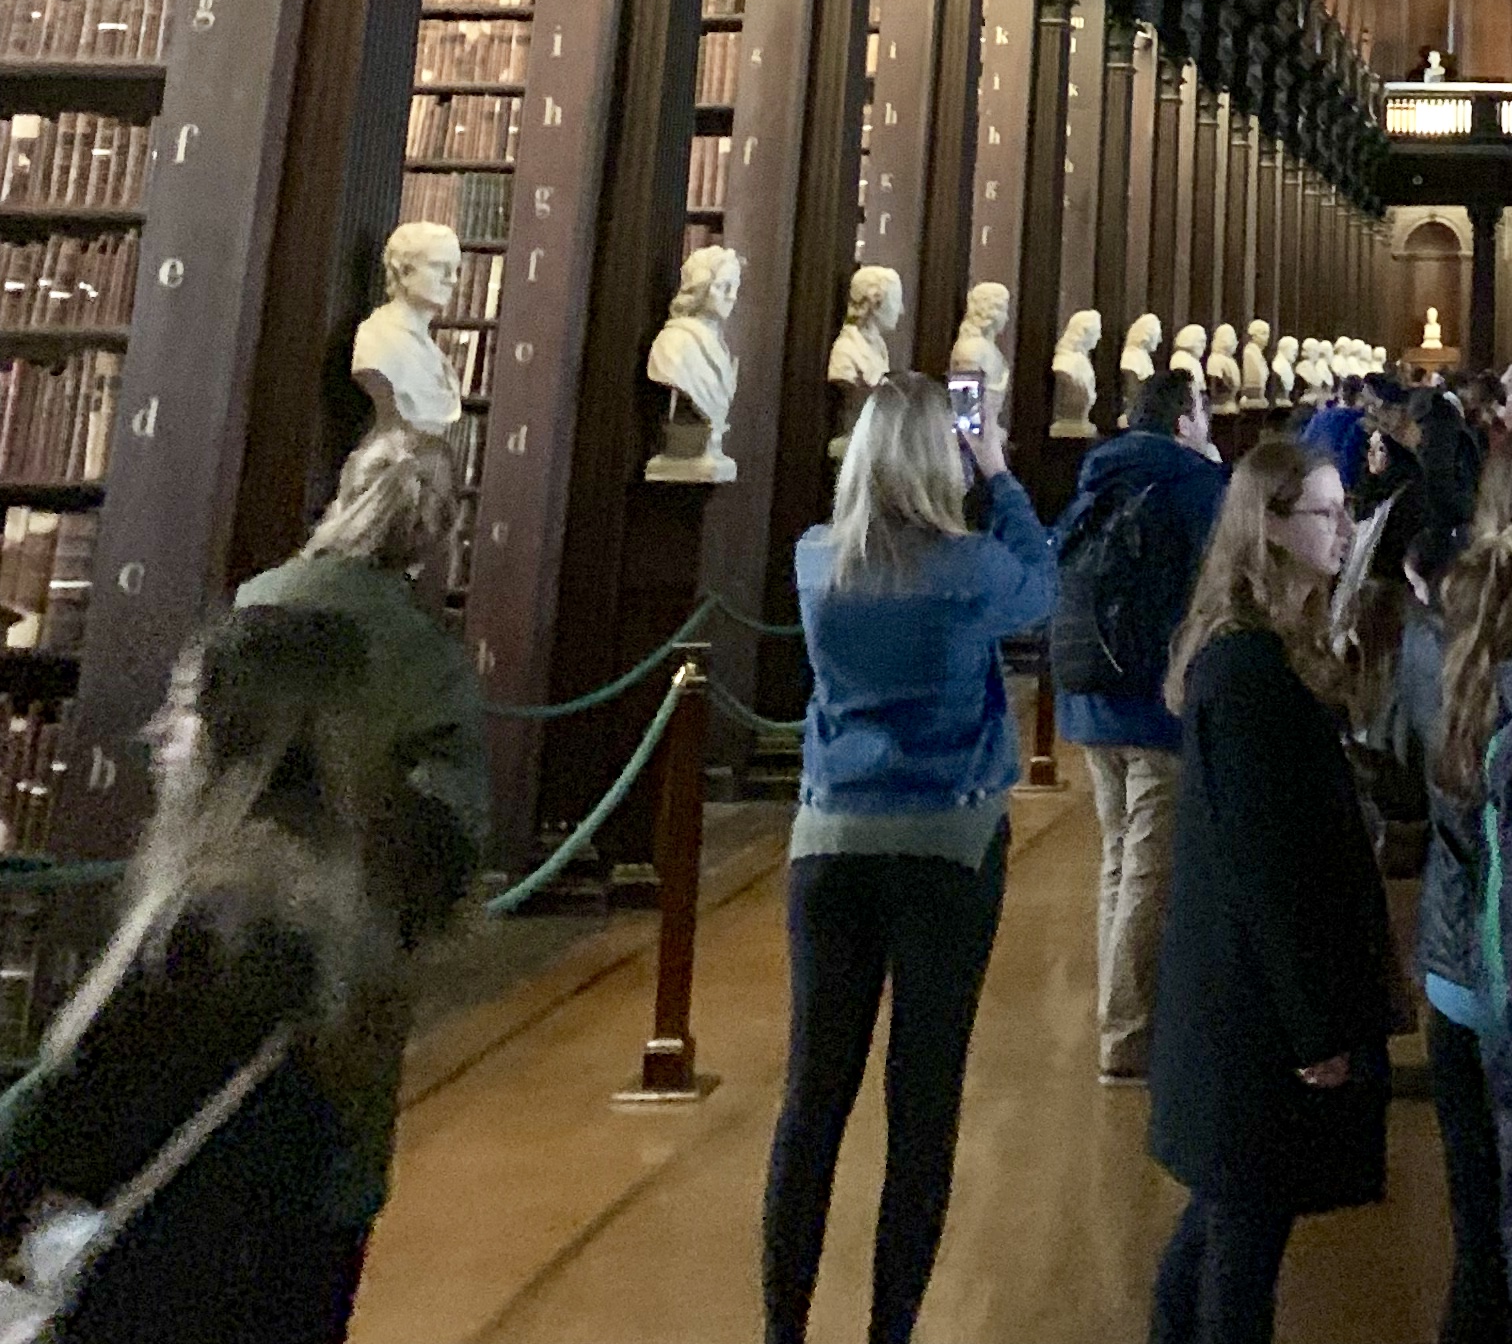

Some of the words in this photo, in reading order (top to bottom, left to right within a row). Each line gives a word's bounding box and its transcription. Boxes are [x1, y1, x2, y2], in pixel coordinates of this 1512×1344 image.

[996, 26, 1008, 44] k
[544, 97, 561, 125] h
[886, 103, 897, 124] h
[989, 126, 1000, 144] h
[159, 259, 183, 285] e
[133, 398, 158, 436] d
[508, 425, 527, 452] d
